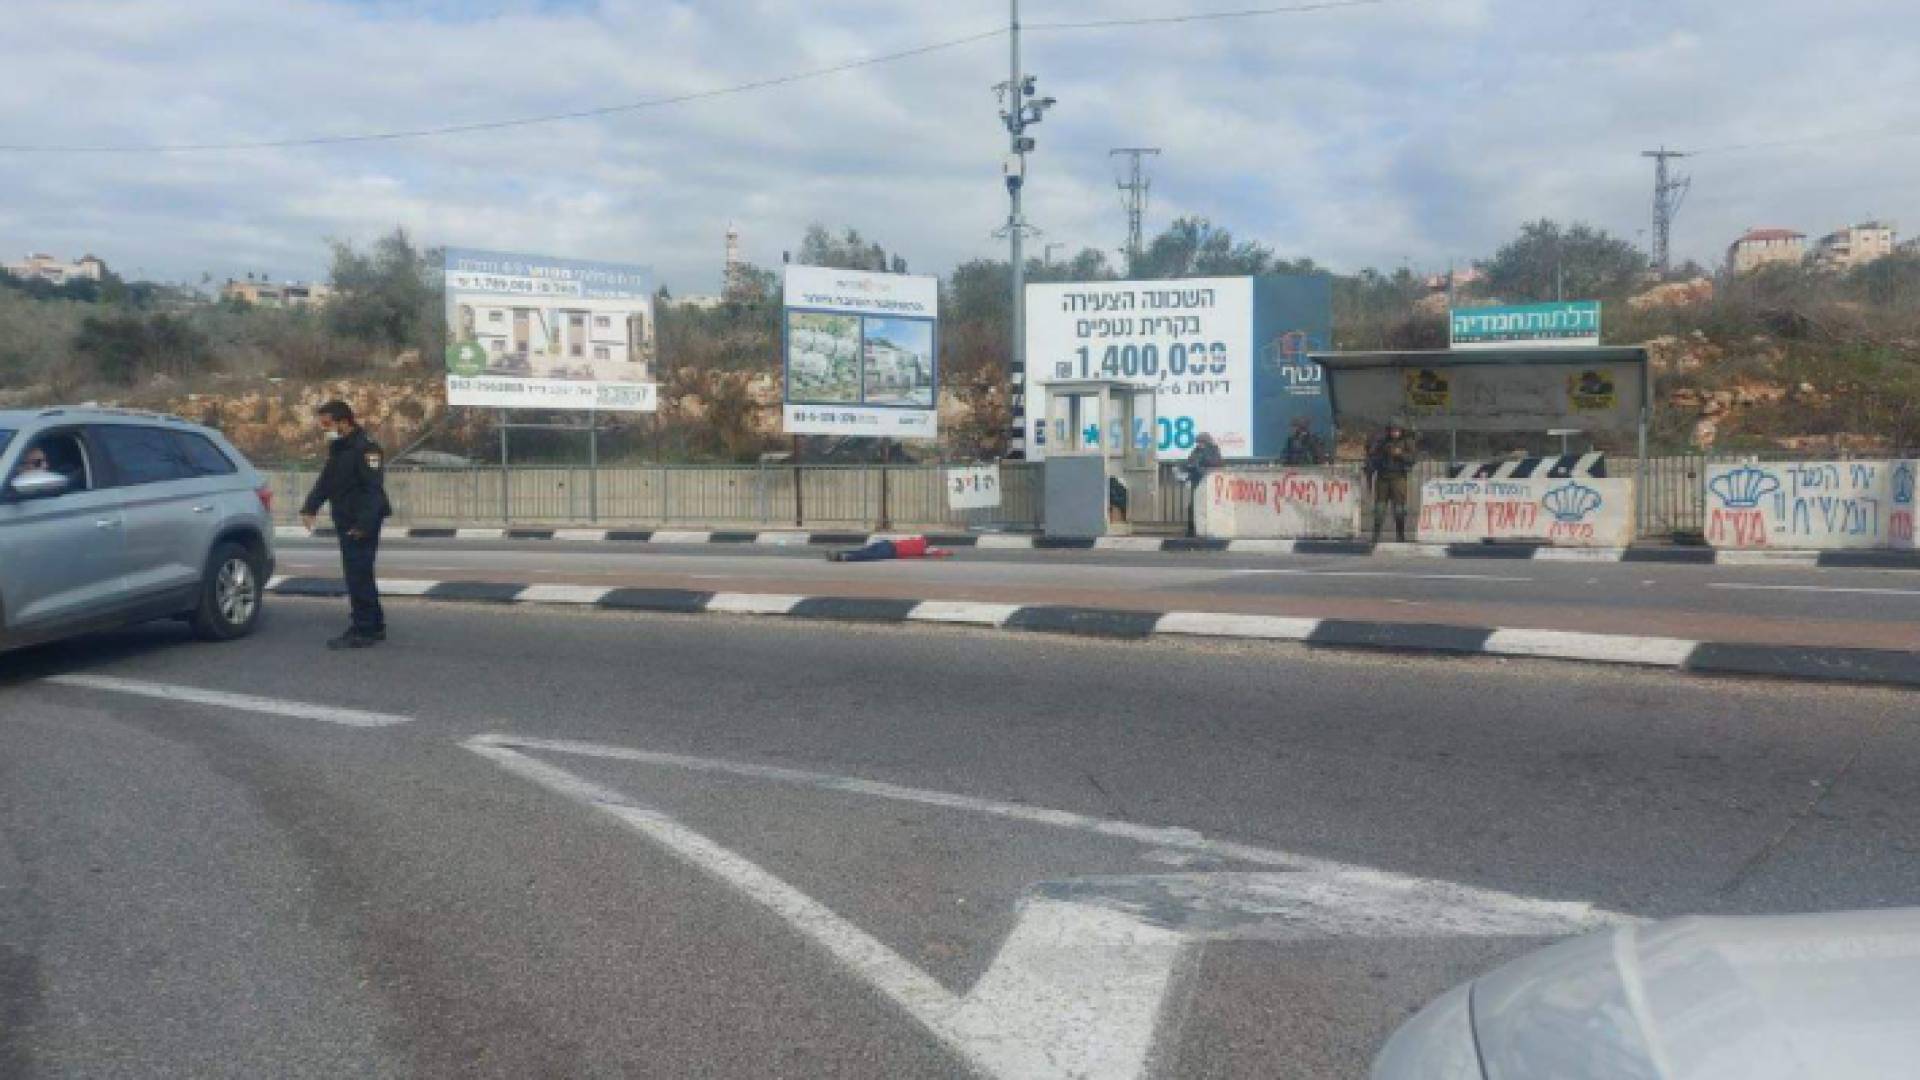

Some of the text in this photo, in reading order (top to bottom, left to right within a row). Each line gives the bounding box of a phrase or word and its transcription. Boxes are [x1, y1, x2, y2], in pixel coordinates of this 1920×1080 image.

[1062, 288, 1216, 312] השכונה הצעירה
[1076, 315, 1201, 339] בקרית נטפים
